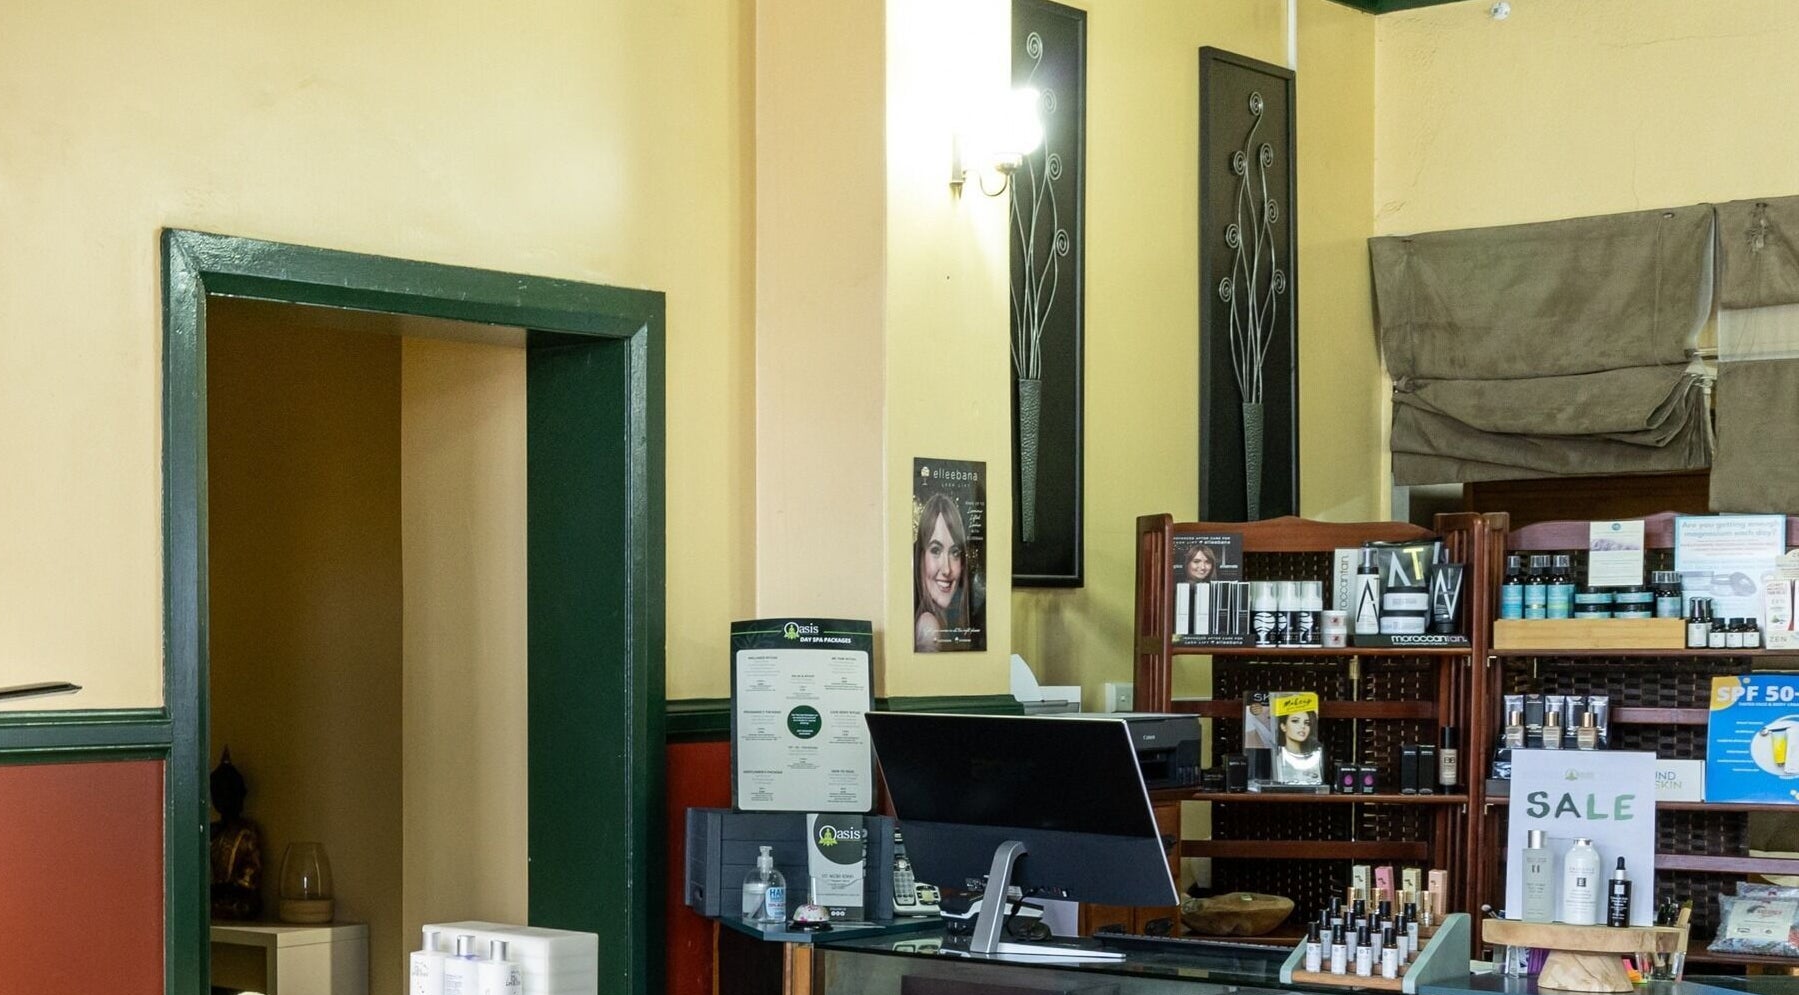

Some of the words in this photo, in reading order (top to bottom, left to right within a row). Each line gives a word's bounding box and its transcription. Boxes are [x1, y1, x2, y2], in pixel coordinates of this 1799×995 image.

[933, 468, 978, 481] elleebana
[1699, 522, 1715, 530] you
[1716, 521, 1746, 530] getting
[784, 621, 819, 637] Oasis
[1716, 685, 1759, 702] SPF
[1526, 791, 1636, 821] SALE
[819, 825, 861, 841] Oasis
